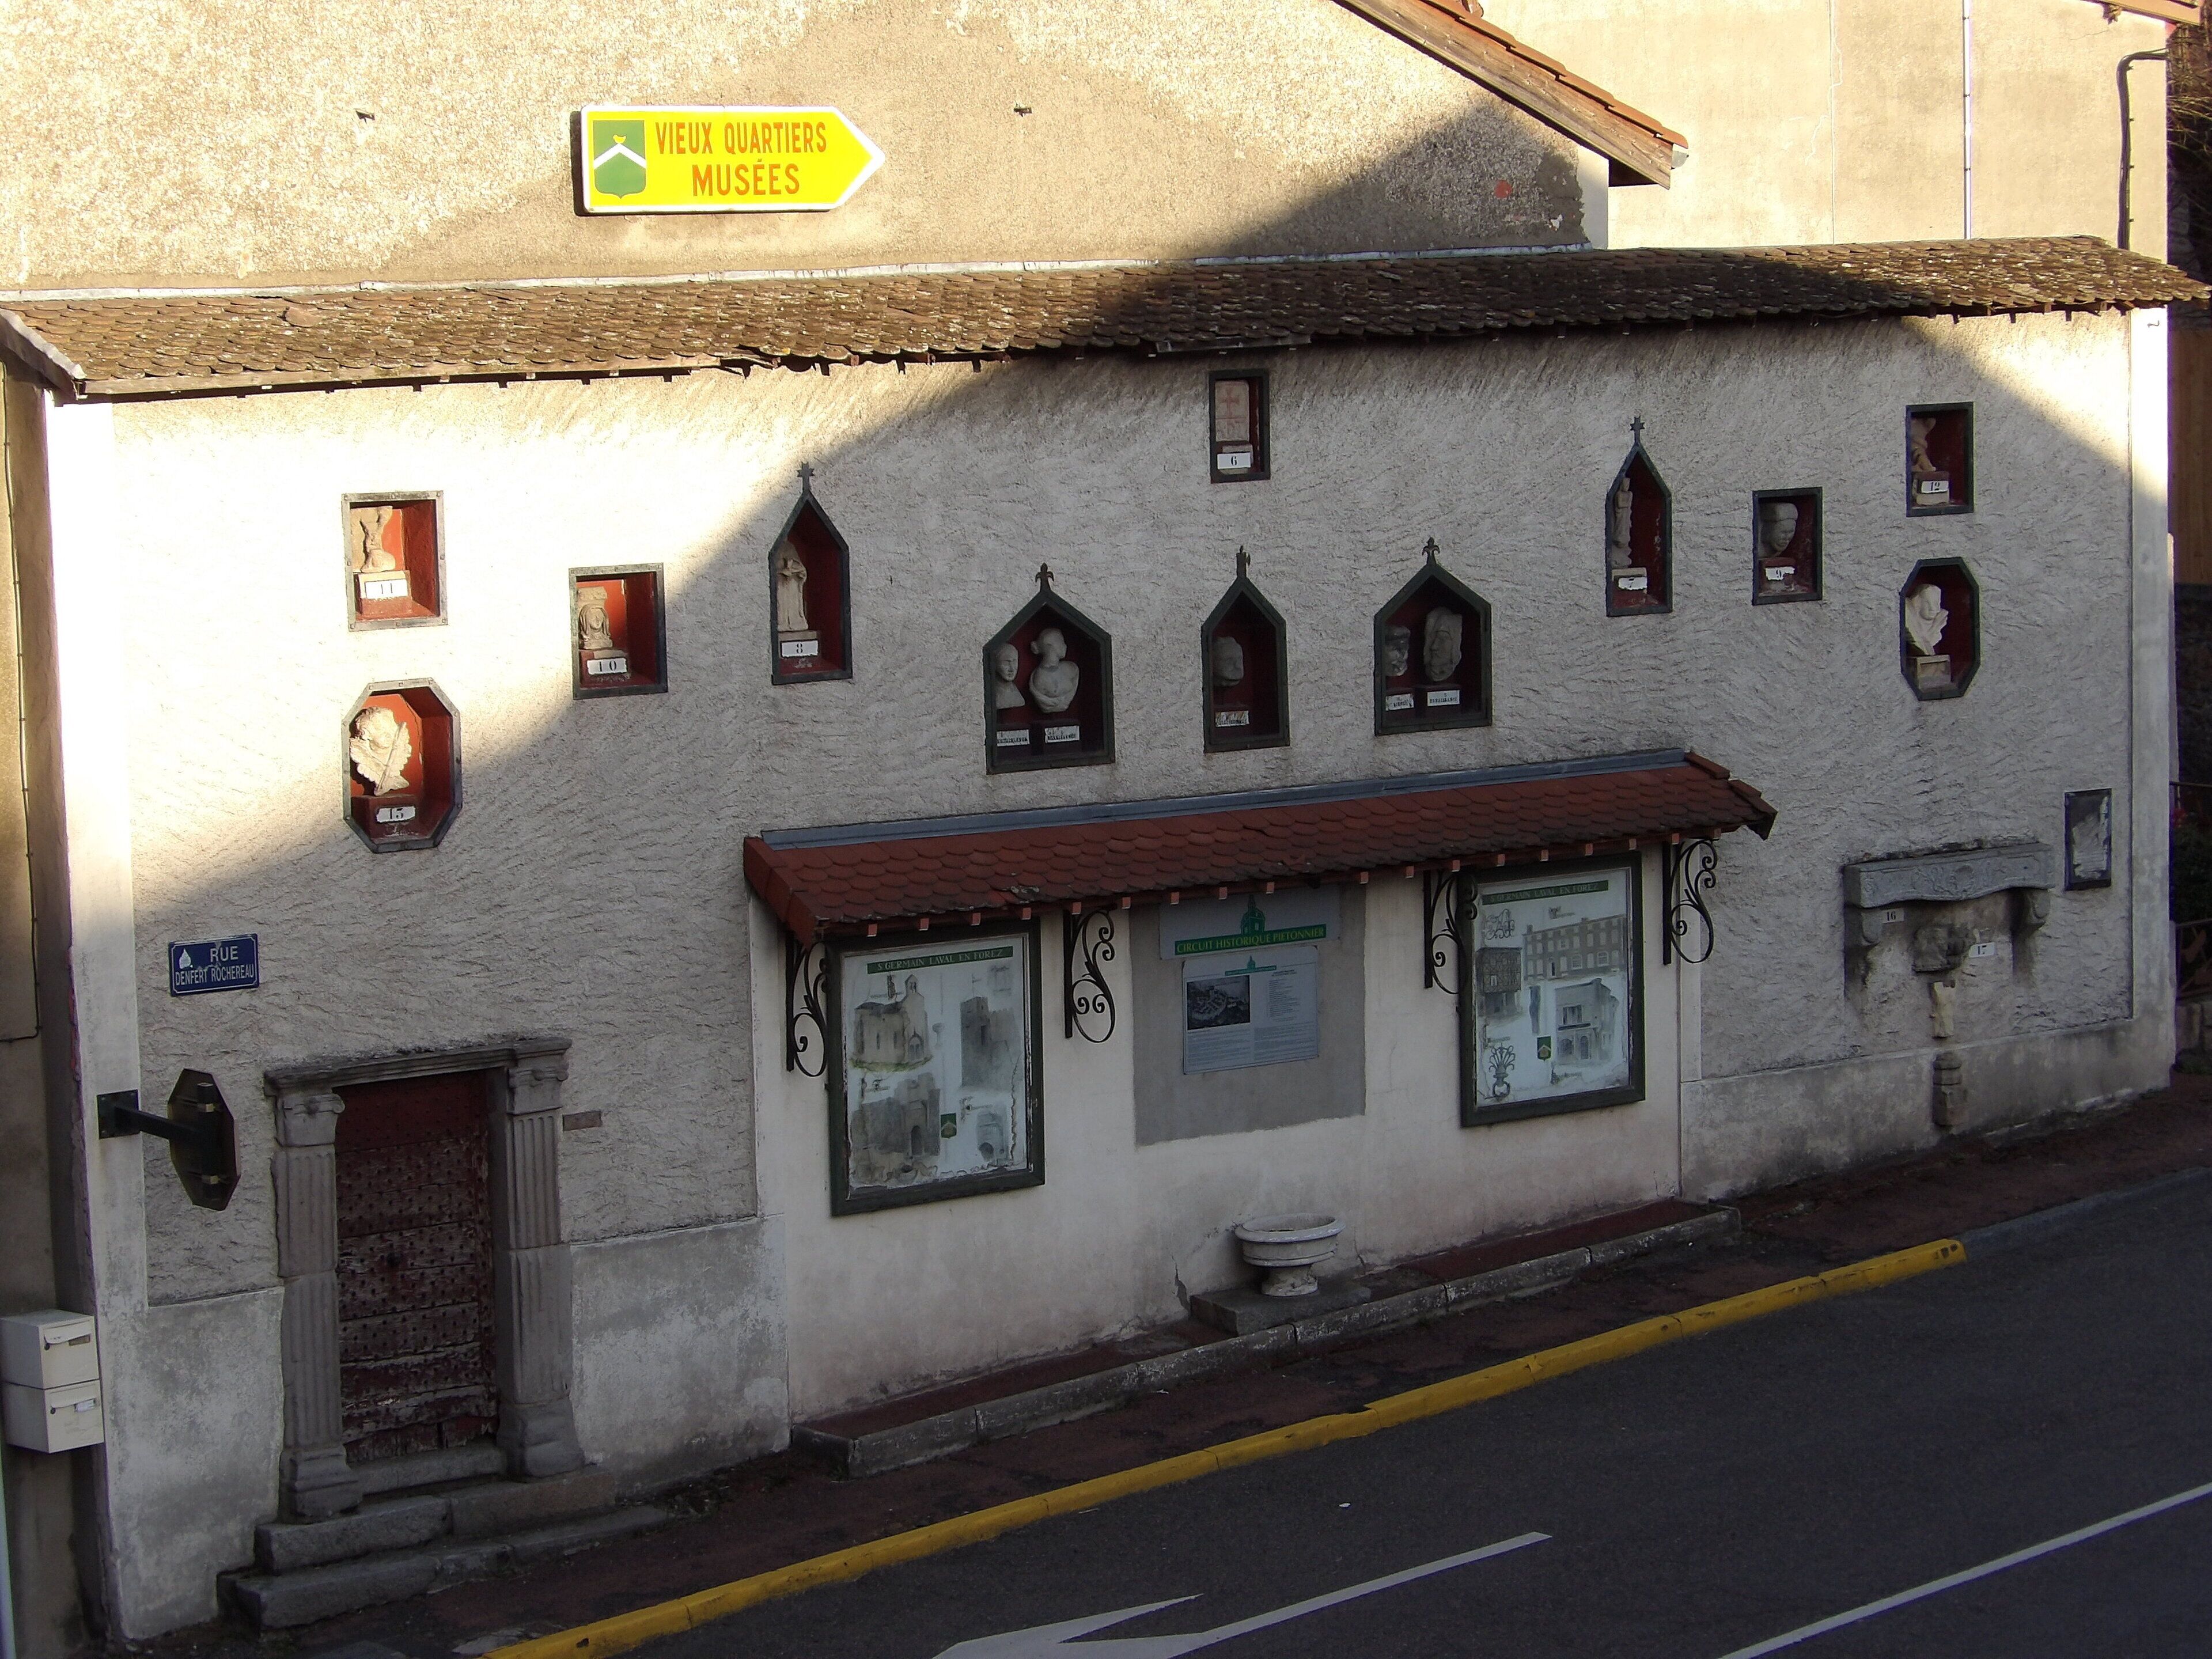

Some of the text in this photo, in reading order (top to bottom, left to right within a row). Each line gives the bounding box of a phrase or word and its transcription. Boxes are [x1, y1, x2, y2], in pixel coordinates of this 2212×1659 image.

[656, 122, 827, 154] VIEUX QUARTIERS
[691, 158, 800, 196] MUSÉES
[1230, 456, 1237, 466] 6
[1776, 569, 1782, 579] 9
[381, 583, 393, 594] 11
[1628, 578, 1635, 588] 7
[797, 643, 803, 654] 8
[599, 660, 616, 671] 10
[390, 808, 403, 819] 15
[1887, 912, 1896, 921] 16
[1177, 940, 1213, 953] CIRCUIT
[210, 946, 238, 962] RUE
[885, 959, 924, 969] GERMAIN
[930, 955, 955, 965] LAVAL
[959, 953, 970, 961] EN
[974, 949, 1003, 960] FOREZ
[175, 964, 254, 986] DENFERT ROCHEREAU
